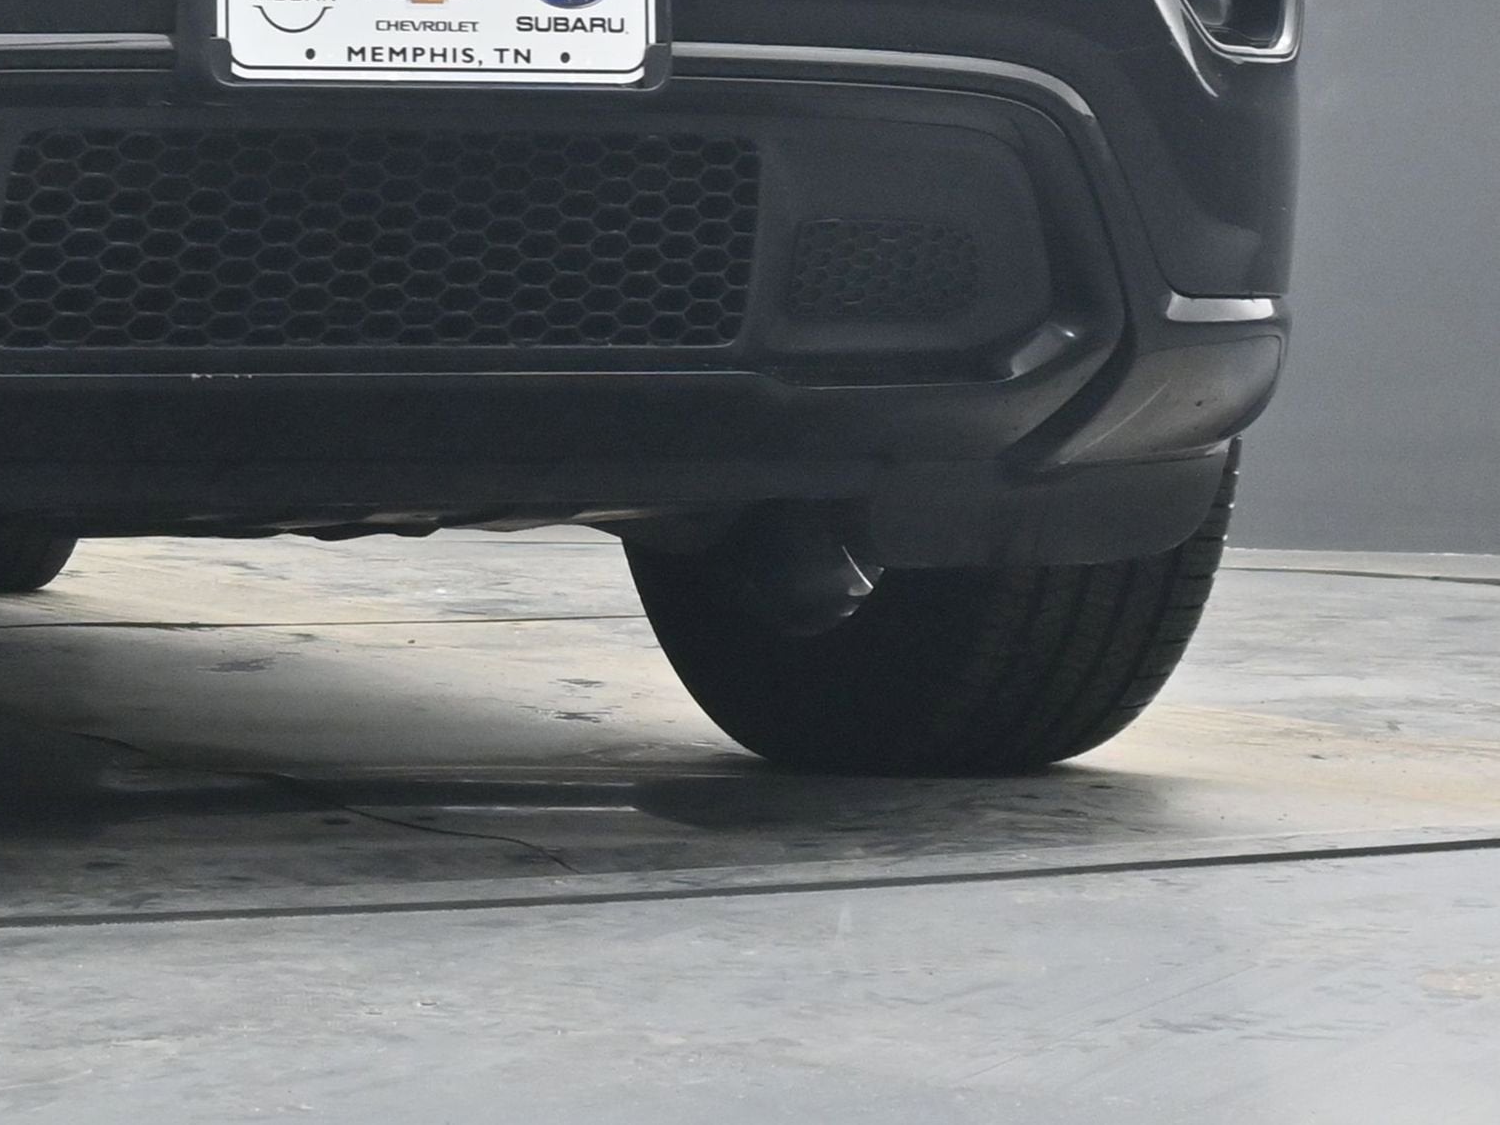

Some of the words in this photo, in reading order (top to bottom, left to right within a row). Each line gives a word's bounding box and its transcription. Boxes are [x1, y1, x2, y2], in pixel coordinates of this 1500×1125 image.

[375, 20, 481, 33] CHEVROLET
[515, 16, 625, 33] SUBARU
[346, 45, 483, 66] MEMPHIS,
[493, 47, 532, 64] TN
